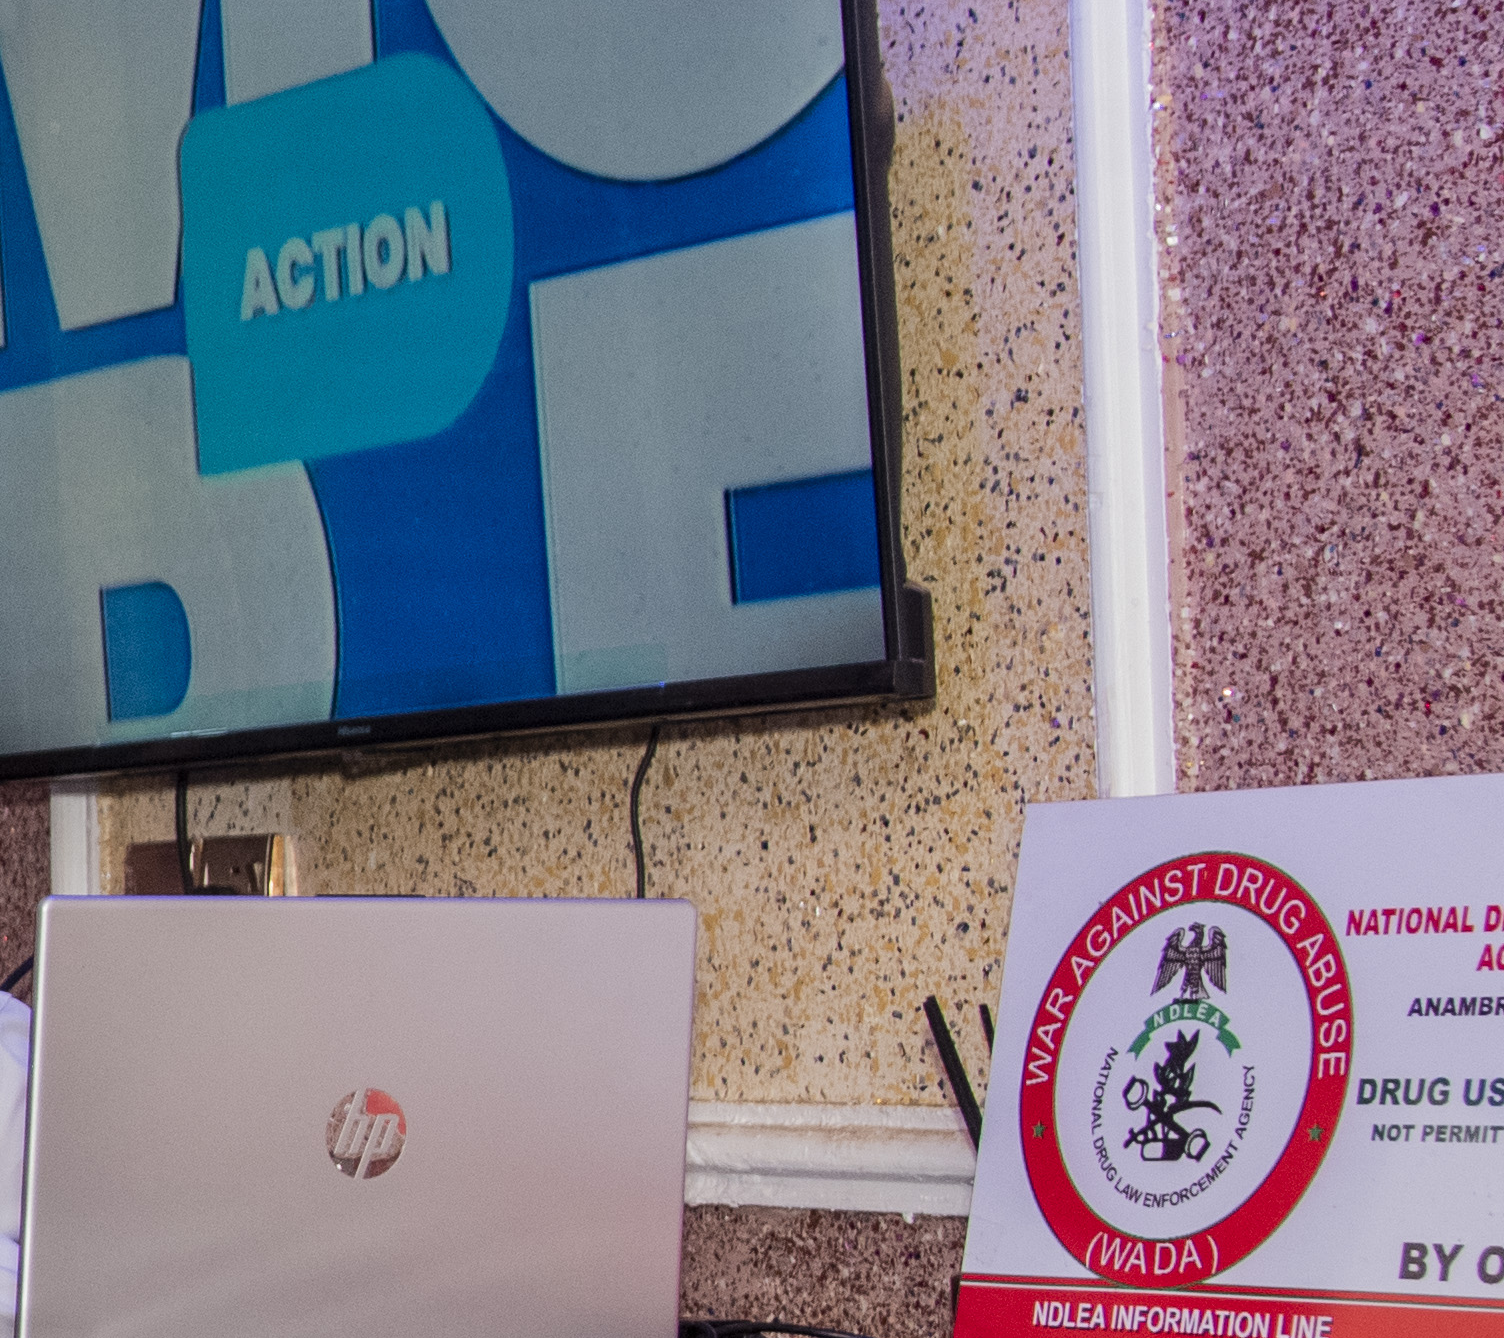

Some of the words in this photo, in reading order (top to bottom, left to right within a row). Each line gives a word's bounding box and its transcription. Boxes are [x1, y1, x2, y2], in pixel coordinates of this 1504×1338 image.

[241, 200, 451, 321] ACTION
[1346, 906, 1475, 936] NATIONAL
[1025, 988, 1074, 1086] WAR
[1069, 862, 1207, 986] AGAINST
[1214, 863, 1306, 935] DRUG
[1297, 933, 1347, 1080] ABUSE
[1152, 1004, 1222, 1028] NDLEA
[1091, 1046, 1120, 1136] NATIONAL
[1234, 1065, 1257, 1140] AGENCY
[1356, 1077, 1451, 1106] DRUG
[332, 1088, 402, 1180] hp
[1371, 1124, 1415, 1142] NOT
[1092, 1136, 1118, 1182] DRUG
[1142, 1139, 1238, 1208] ENFORCEMENT
[1114, 1177, 1143, 1204] LAW
[1398, 1242, 1465, 1282] BY
[1033, 1301, 1105, 1330] NDLEA
